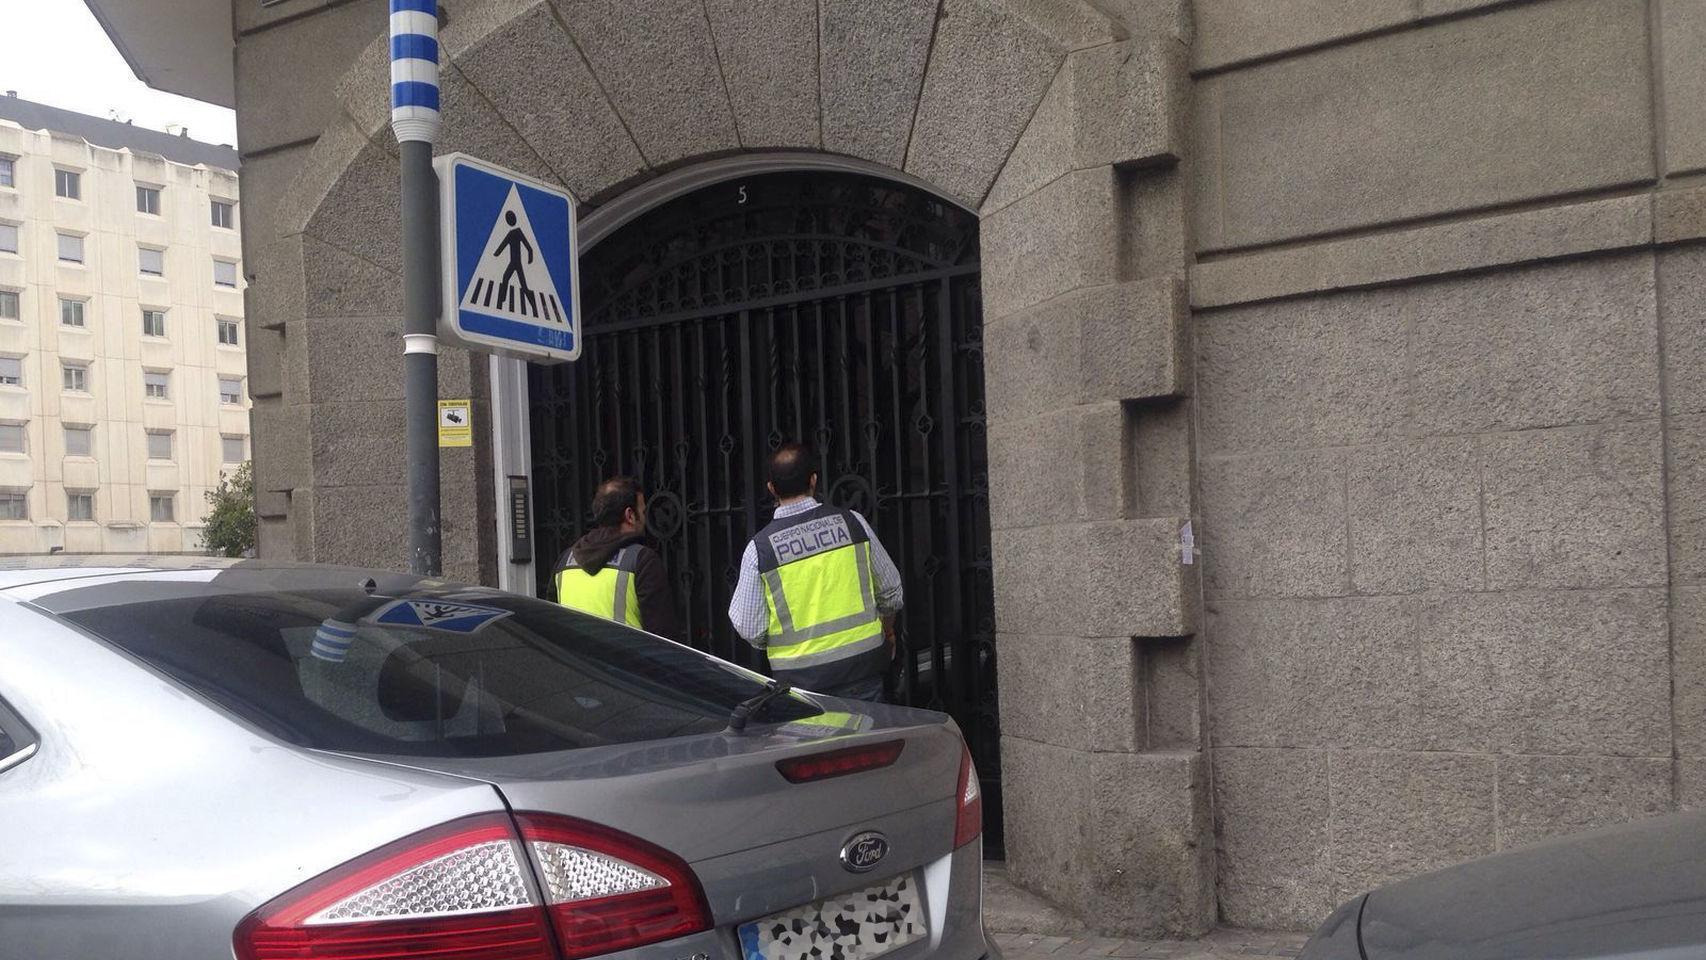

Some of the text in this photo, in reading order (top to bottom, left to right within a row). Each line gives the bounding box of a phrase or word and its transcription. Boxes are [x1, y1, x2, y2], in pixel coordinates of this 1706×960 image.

[738, 185, 747, 204] 5
[773, 516, 844, 544] CUERPO NACIONAL DE
[777, 527, 849, 561] POLICIA
[856, 840, 881, 864] Ford
